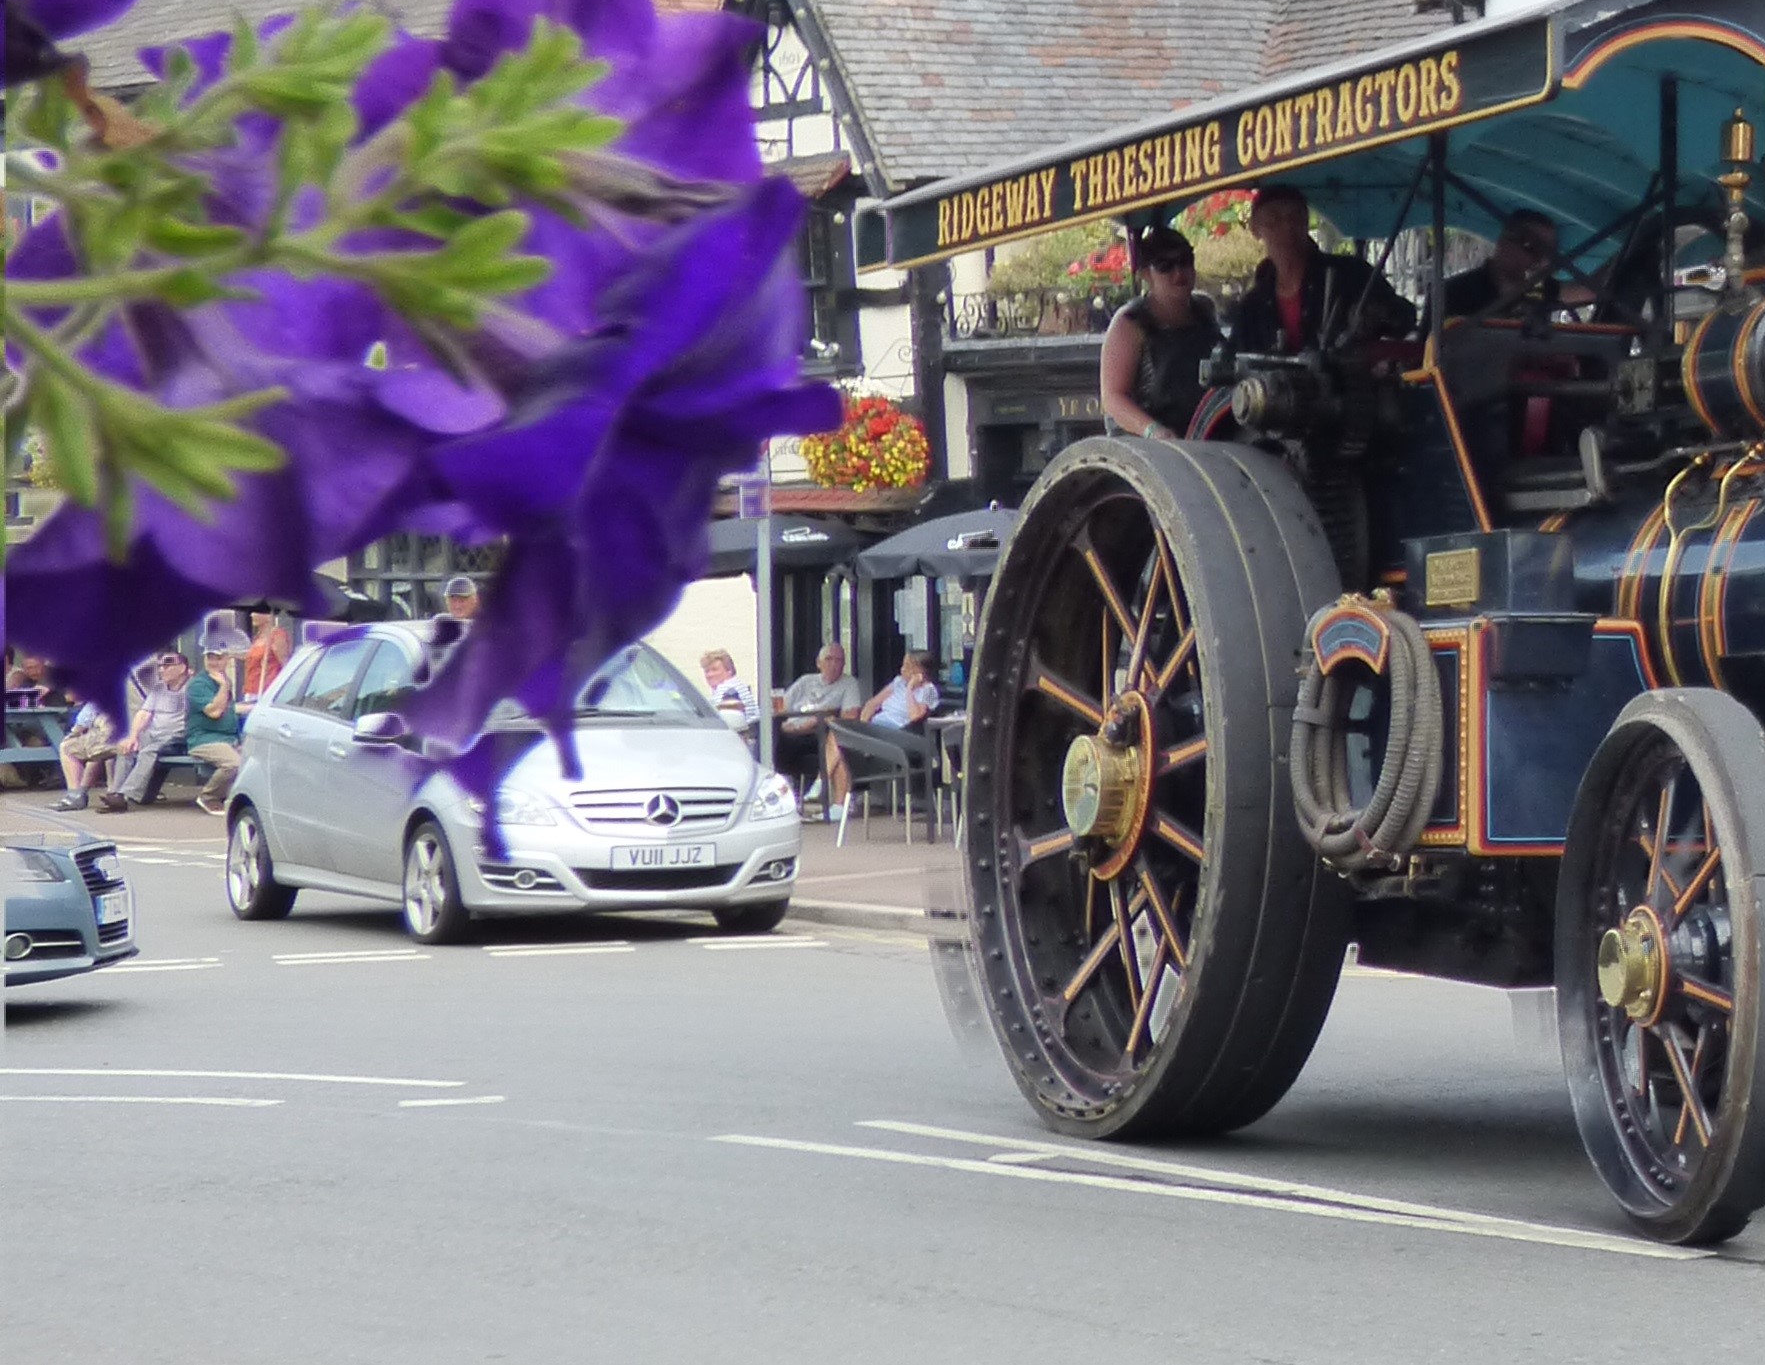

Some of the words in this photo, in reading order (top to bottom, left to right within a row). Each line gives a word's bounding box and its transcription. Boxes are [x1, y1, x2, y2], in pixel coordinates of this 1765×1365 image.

[937, 166, 1056, 247] RIDGEWAY
[1070, 120, 1222, 213] THRESHING
[1236, 50, 1462, 168] CONTRACTORS
[669, 846, 702, 866] JJZ
